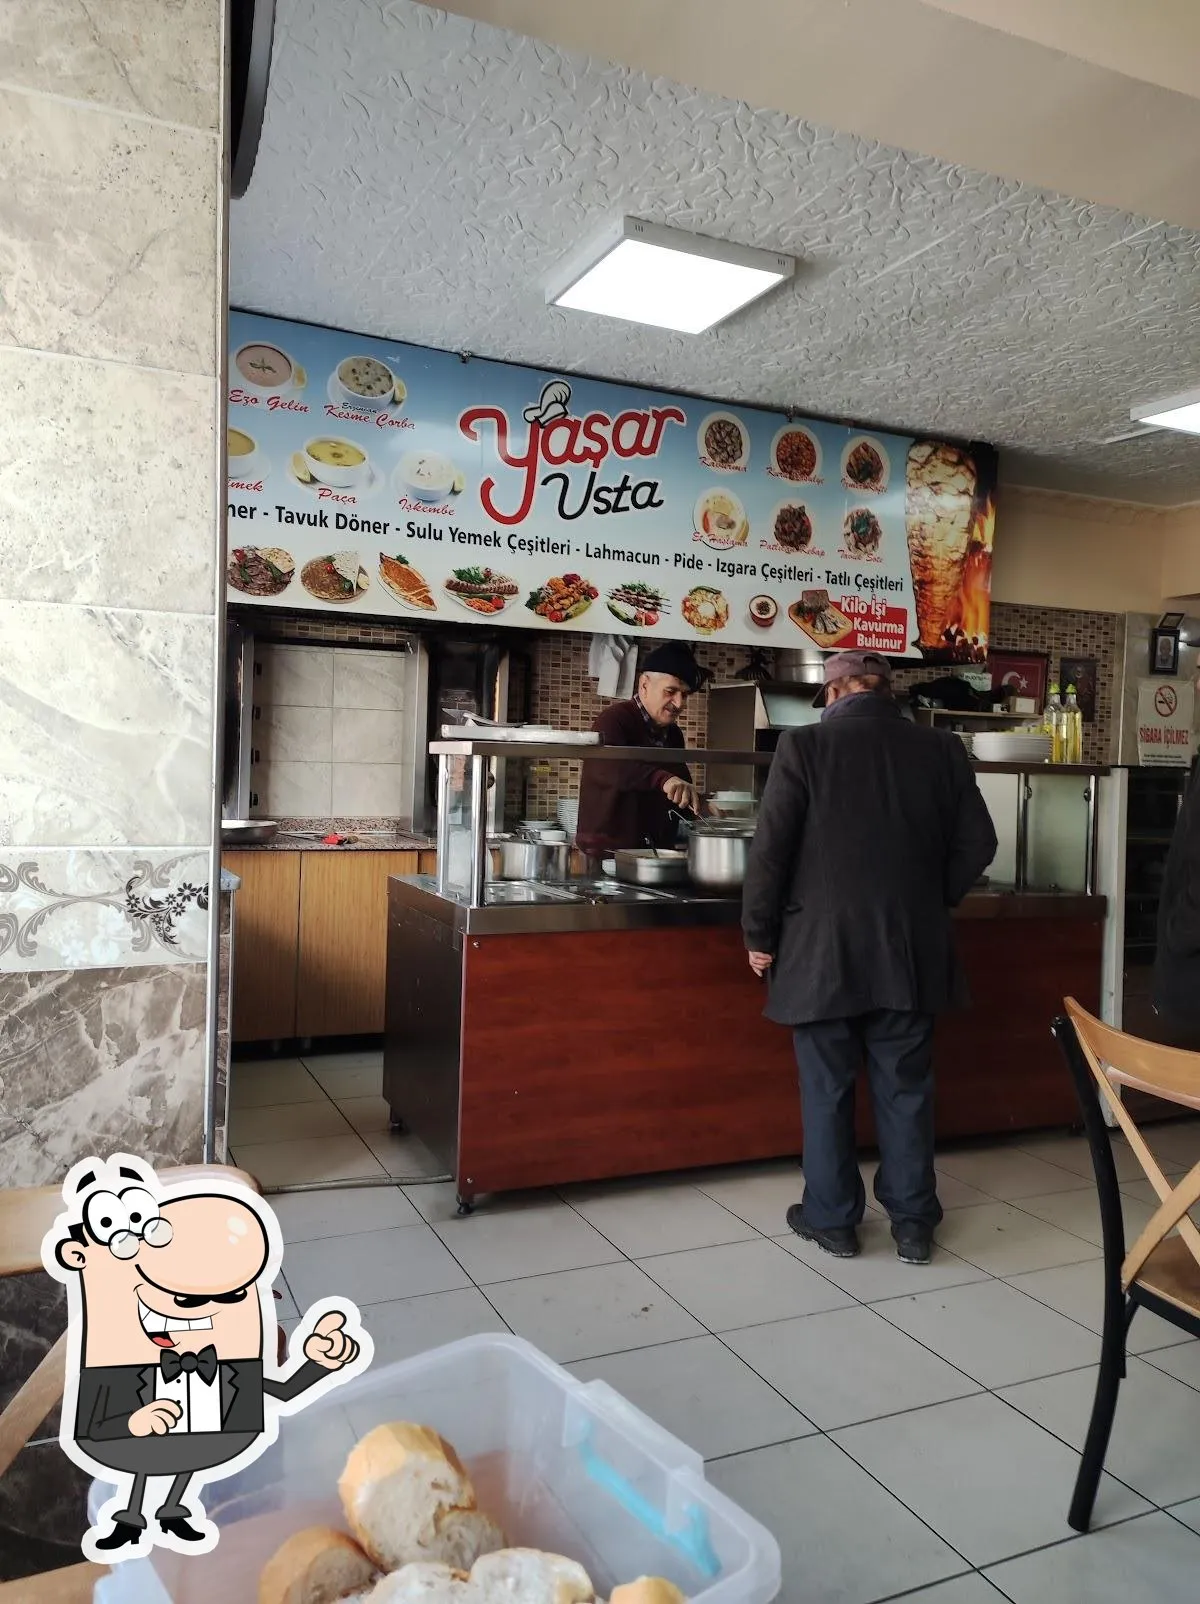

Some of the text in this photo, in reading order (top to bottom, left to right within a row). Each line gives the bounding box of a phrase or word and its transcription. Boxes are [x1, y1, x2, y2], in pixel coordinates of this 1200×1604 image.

[229, 389, 310, 413] Ezo Gelin
[323, 405, 416, 429] Kesme Çorba
[460, 407, 685, 525] Yaşar
[318, 488, 358, 505] Paça
[398, 494, 456, 516] İşkembe
[541, 471, 665, 521] Usta
[275, 505, 329, 528] Tavuk
[336, 511, 390, 535] Döner
[406, 521, 443, 541] Sulu
[448, 526, 502, 548] Yemek
[507, 533, 571, 555] Çeşitleri
[586, 543, 660, 565] Lahmacun
[674, 552, 704, 571] Pide
[716, 557, 757, 578] Izgara
[761, 563, 814, 584] Çeşitleri
[825, 570, 851, 587] Tatlı
[854, 573, 903, 592] Çeşitleri
[841, 594, 888, 619] Kilo İşi
[853, 618, 905, 635] Kavurma
[856, 634, 903, 650] Bulunur
